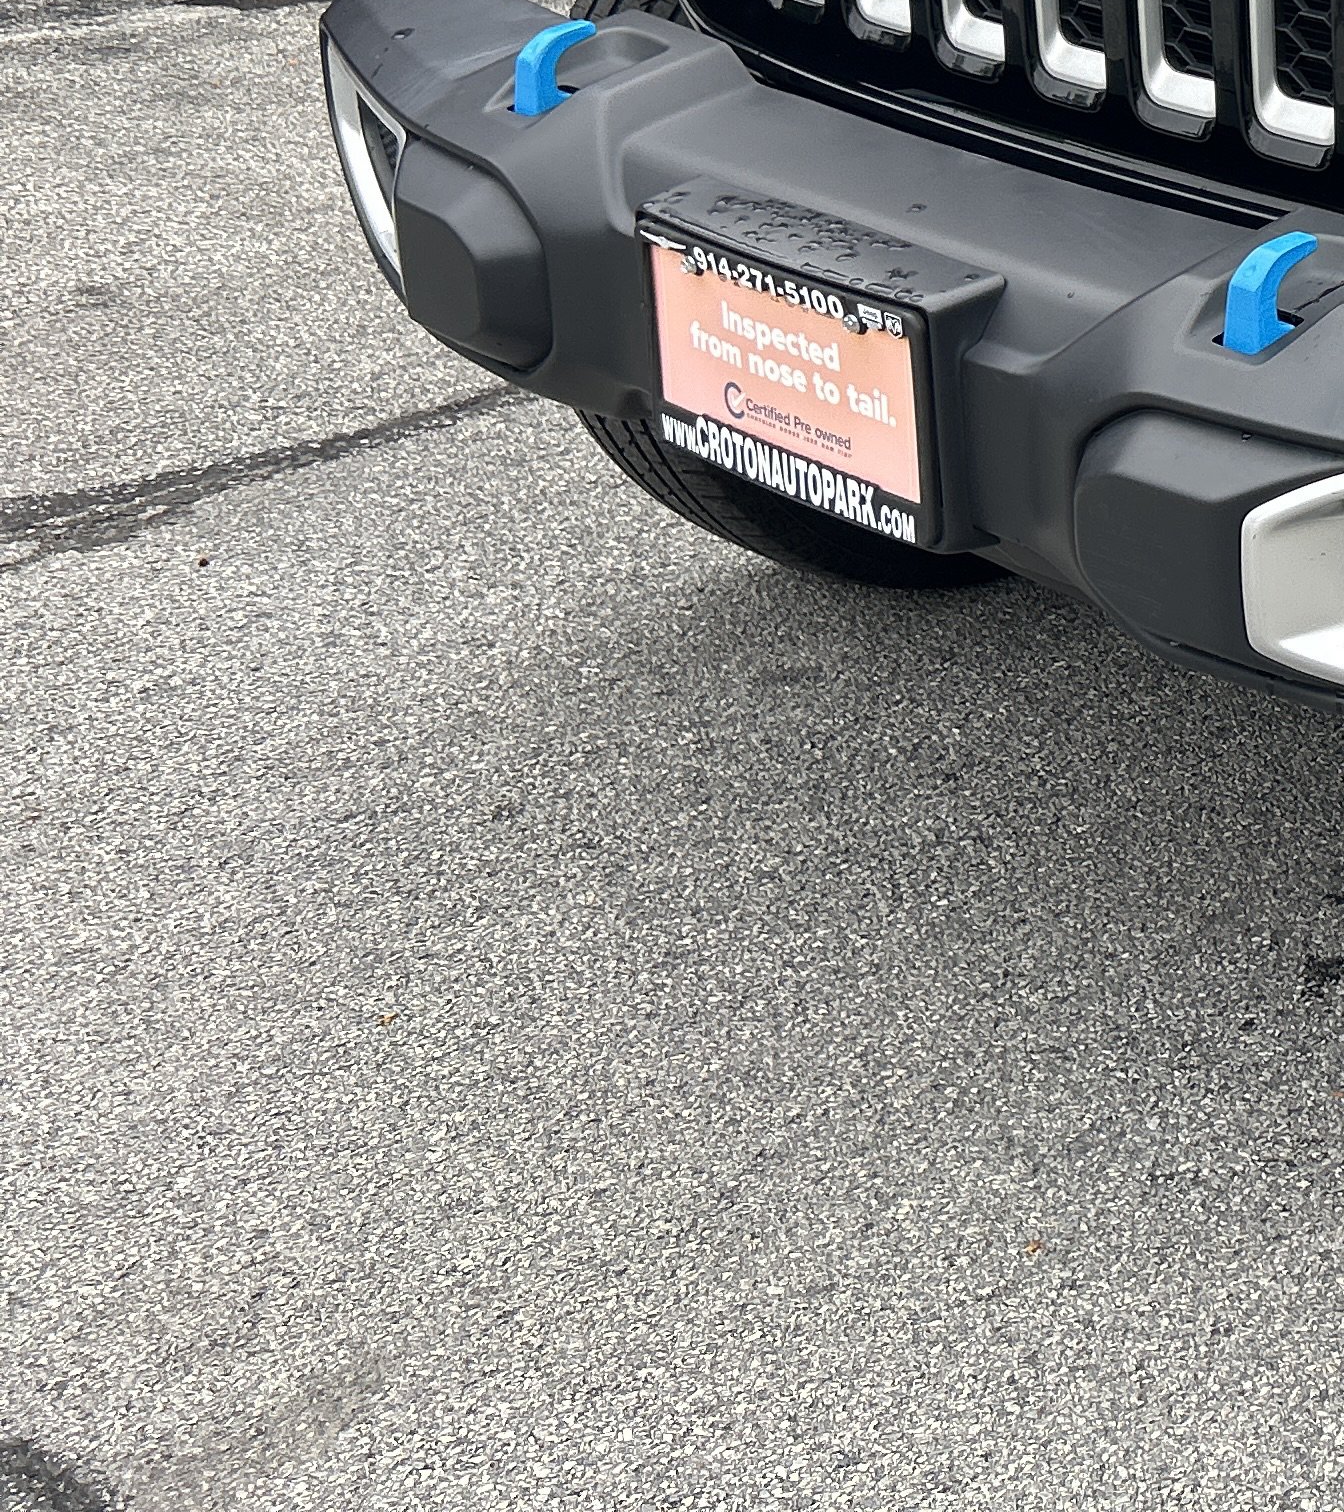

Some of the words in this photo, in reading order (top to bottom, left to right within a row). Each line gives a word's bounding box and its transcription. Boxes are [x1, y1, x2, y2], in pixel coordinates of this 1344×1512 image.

[693, 246, 845, 319] 914-271-5100
[721, 300, 841, 372] Inspected
[690, 321, 743, 370] from
[747, 352, 808, 393] nose
[812, 372, 840, 406] to
[846, 382, 898, 428] tail.
[746, 398, 790, 426] Certified
[793, 416, 812, 435] Pre
[814, 427, 852, 451] owned
